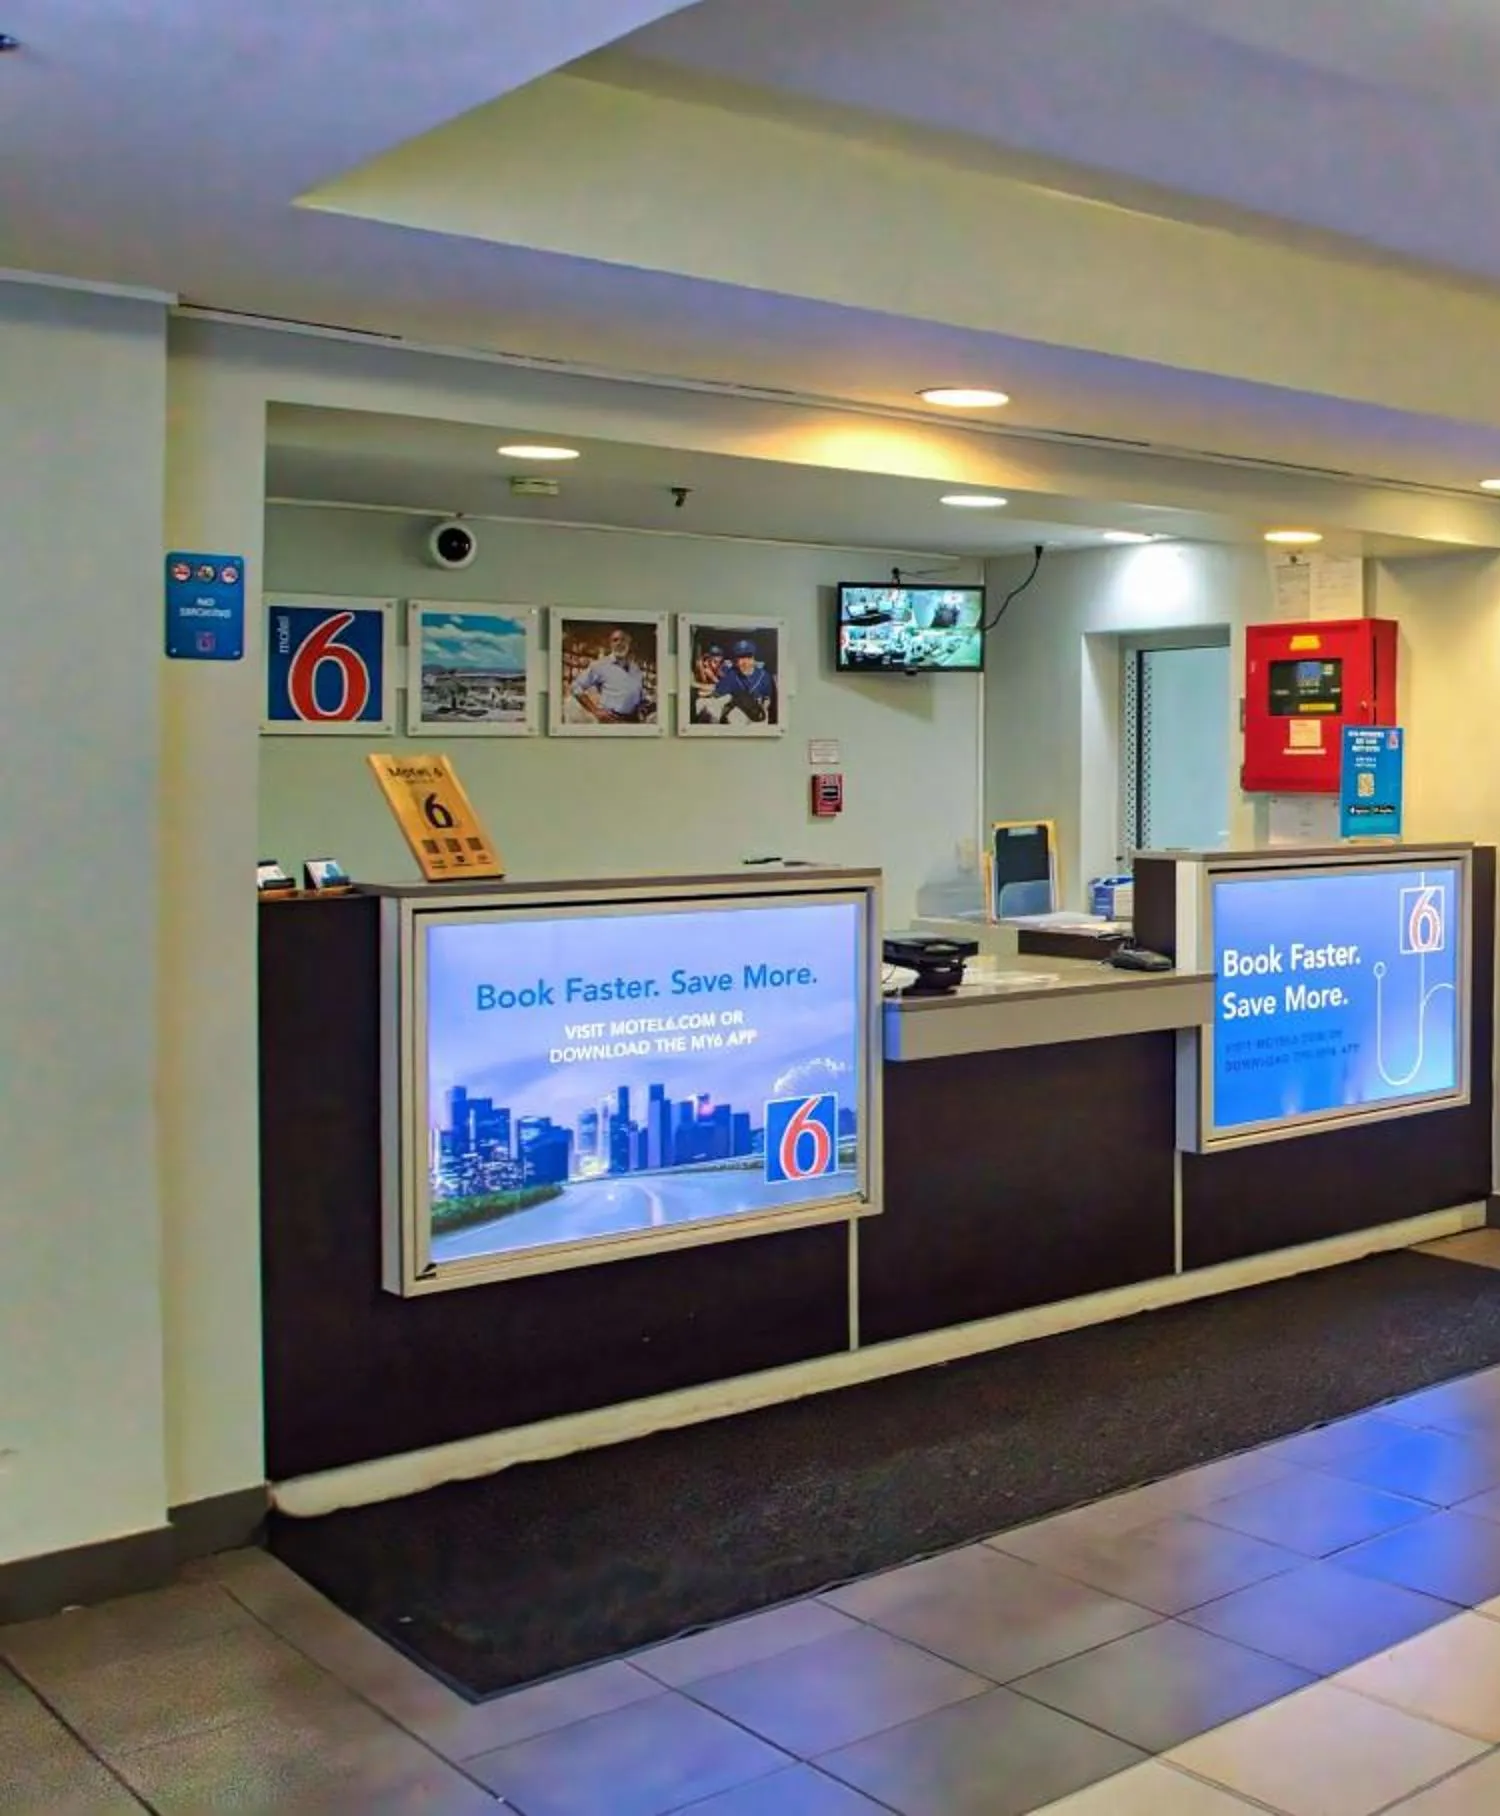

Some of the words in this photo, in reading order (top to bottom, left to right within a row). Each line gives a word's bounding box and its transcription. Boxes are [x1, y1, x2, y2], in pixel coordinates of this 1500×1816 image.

[277, 614, 289, 653] motel
[288, 611, 369, 722] 6
[424, 791, 454, 829] 6
[1409, 886, 1442, 952] 6
[1222, 943, 1283, 977] Book
[1290, 942, 1361, 971] Faster.
[477, 978, 555, 1011] Book
[565, 976, 660, 1004] Faster.
[671, 968, 733, 995] Save
[743, 963, 818, 990] More.
[1222, 990, 1277, 1020] Save
[1285, 983, 1350, 1013] More.
[564, 1023, 606, 1040] VISIT
[610, 1012, 716, 1037] MOTEL6.COM
[720, 1009, 744, 1026] OR
[550, 1040, 650, 1063] DOWNLOAD
[655, 1036, 687, 1053] THE
[726, 1028, 758, 1047] APP
[779, 1094, 831, 1180] 6
